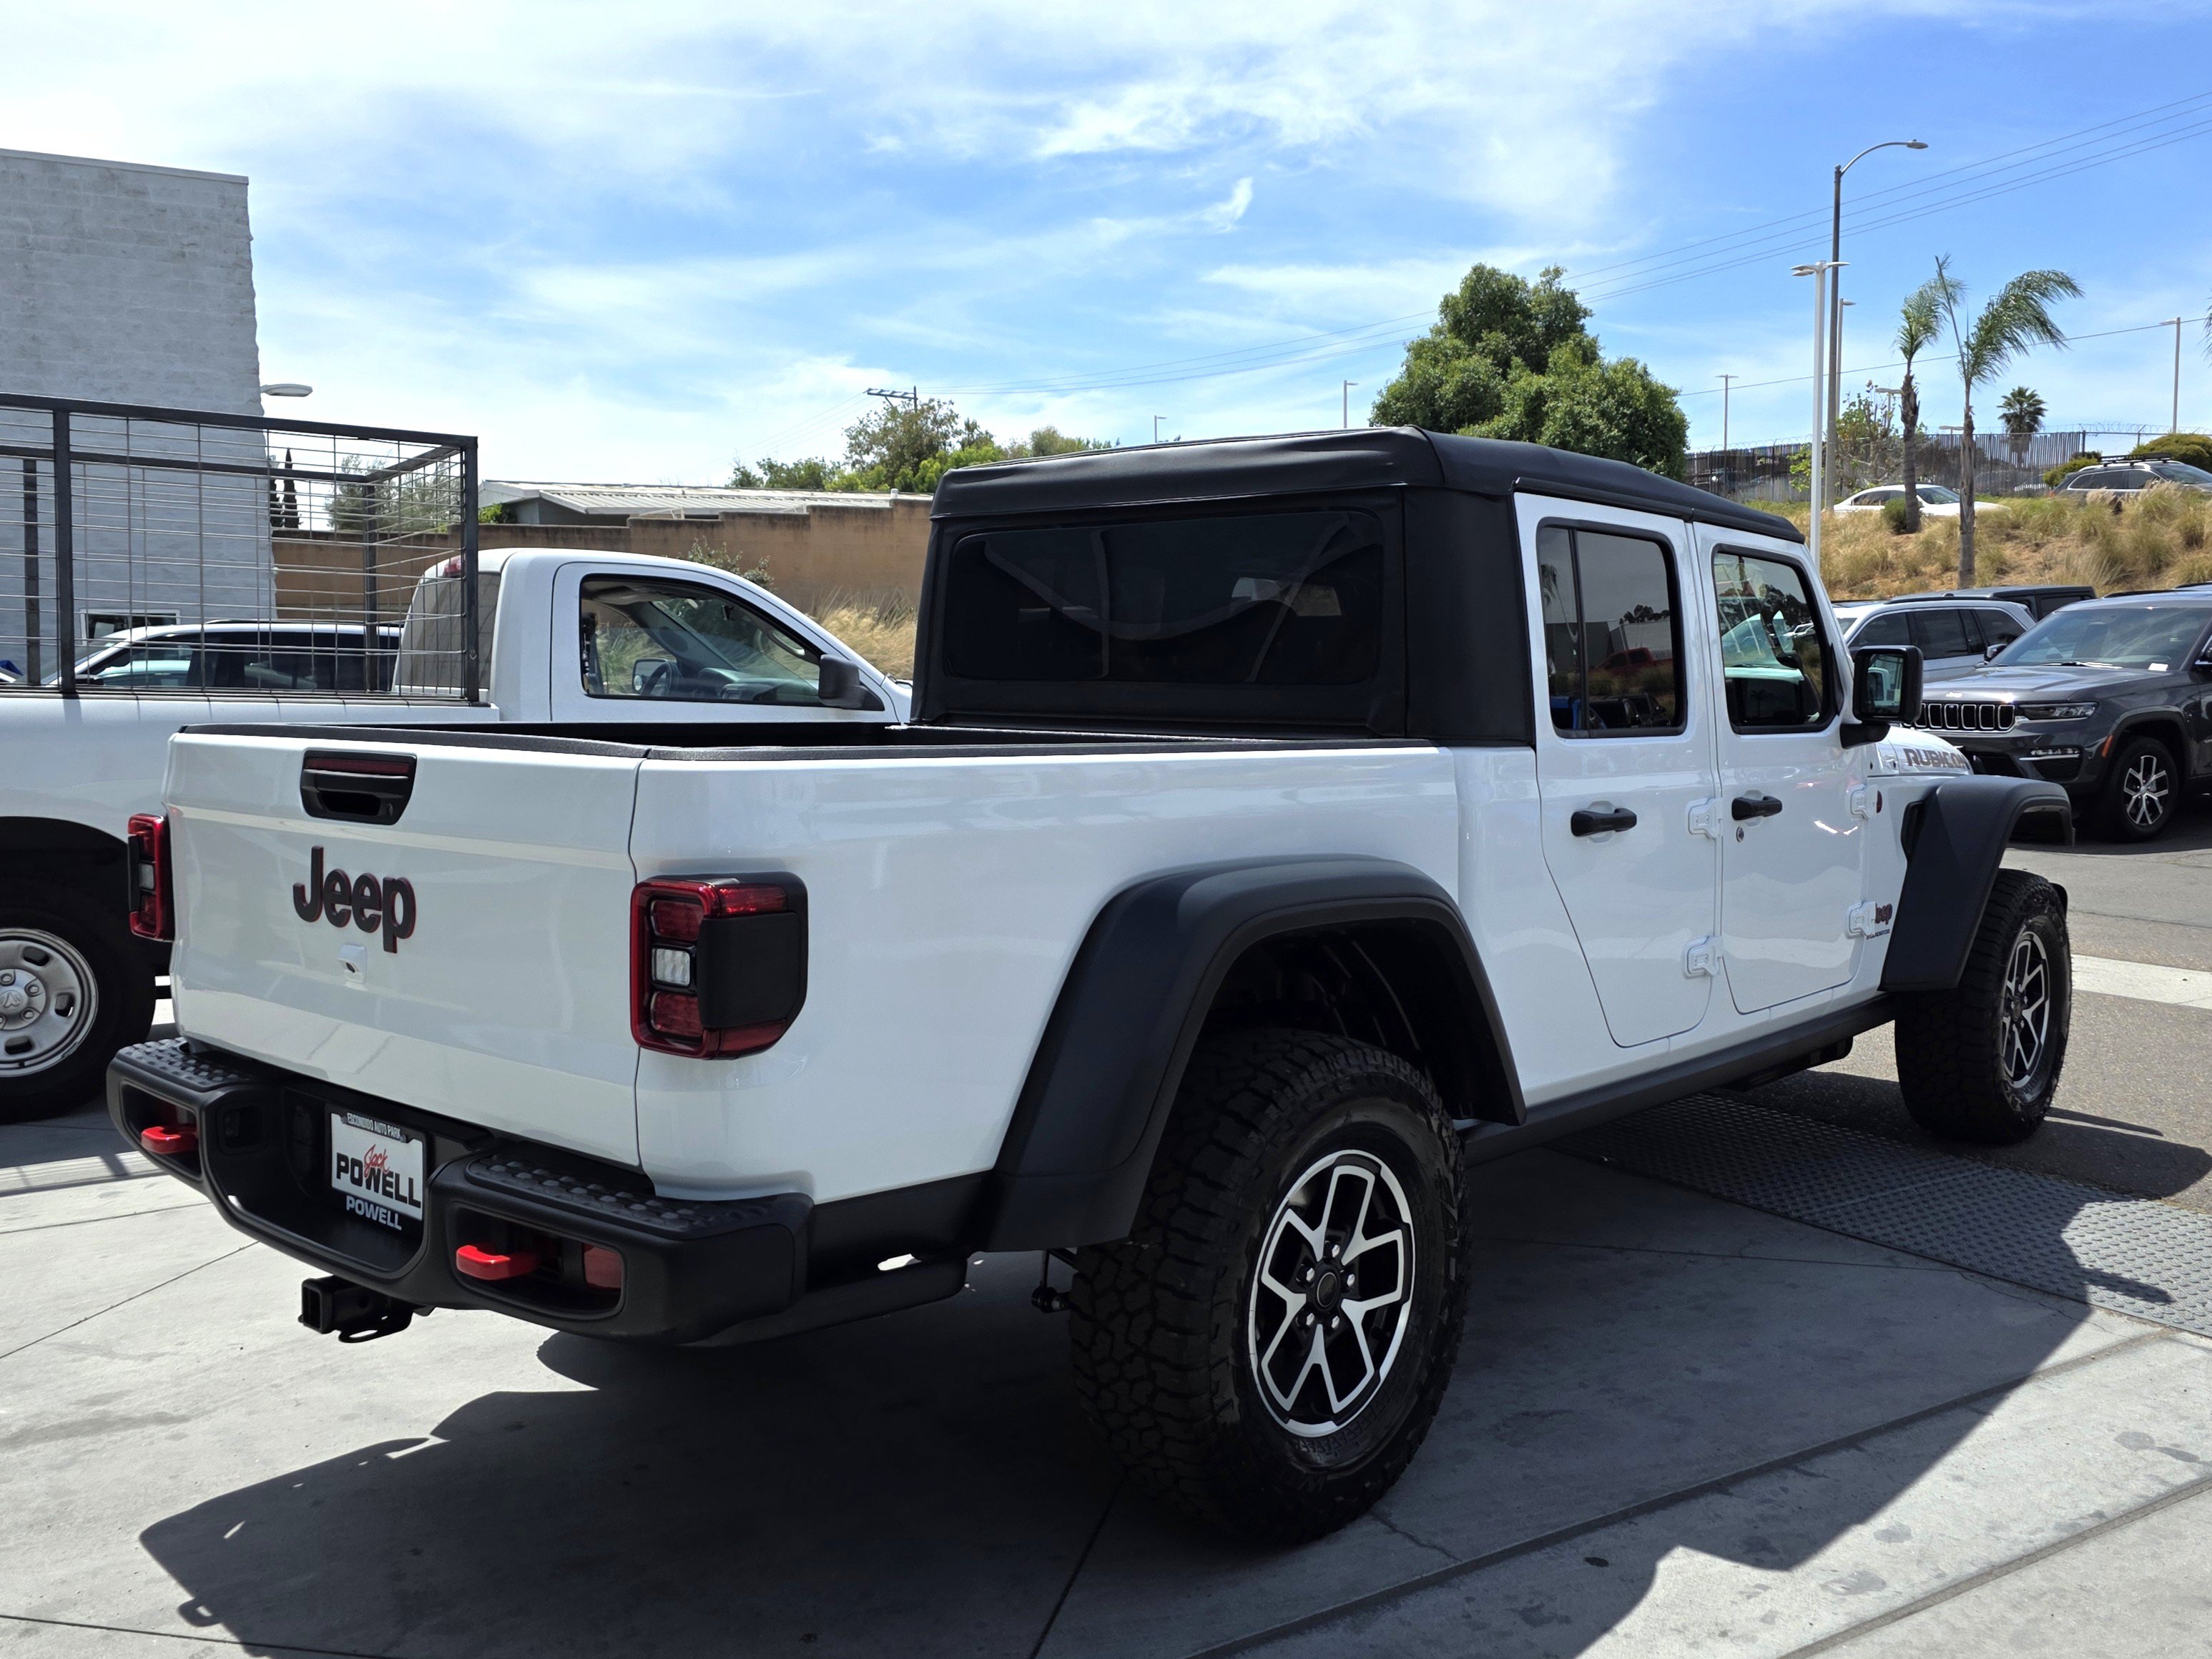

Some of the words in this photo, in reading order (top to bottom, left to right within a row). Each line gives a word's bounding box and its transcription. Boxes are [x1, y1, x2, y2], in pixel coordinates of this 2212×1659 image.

[1902, 748, 1971, 770] RUBICON
[292, 845, 416, 953] Jeep
[374, 1121, 387, 1135] AUTO
[387, 1125, 402, 1139] PARK
[363, 1143, 390, 1178] Jack
[336, 1151, 421, 1208] POWELL
[345, 1195, 402, 1231] POWELL
